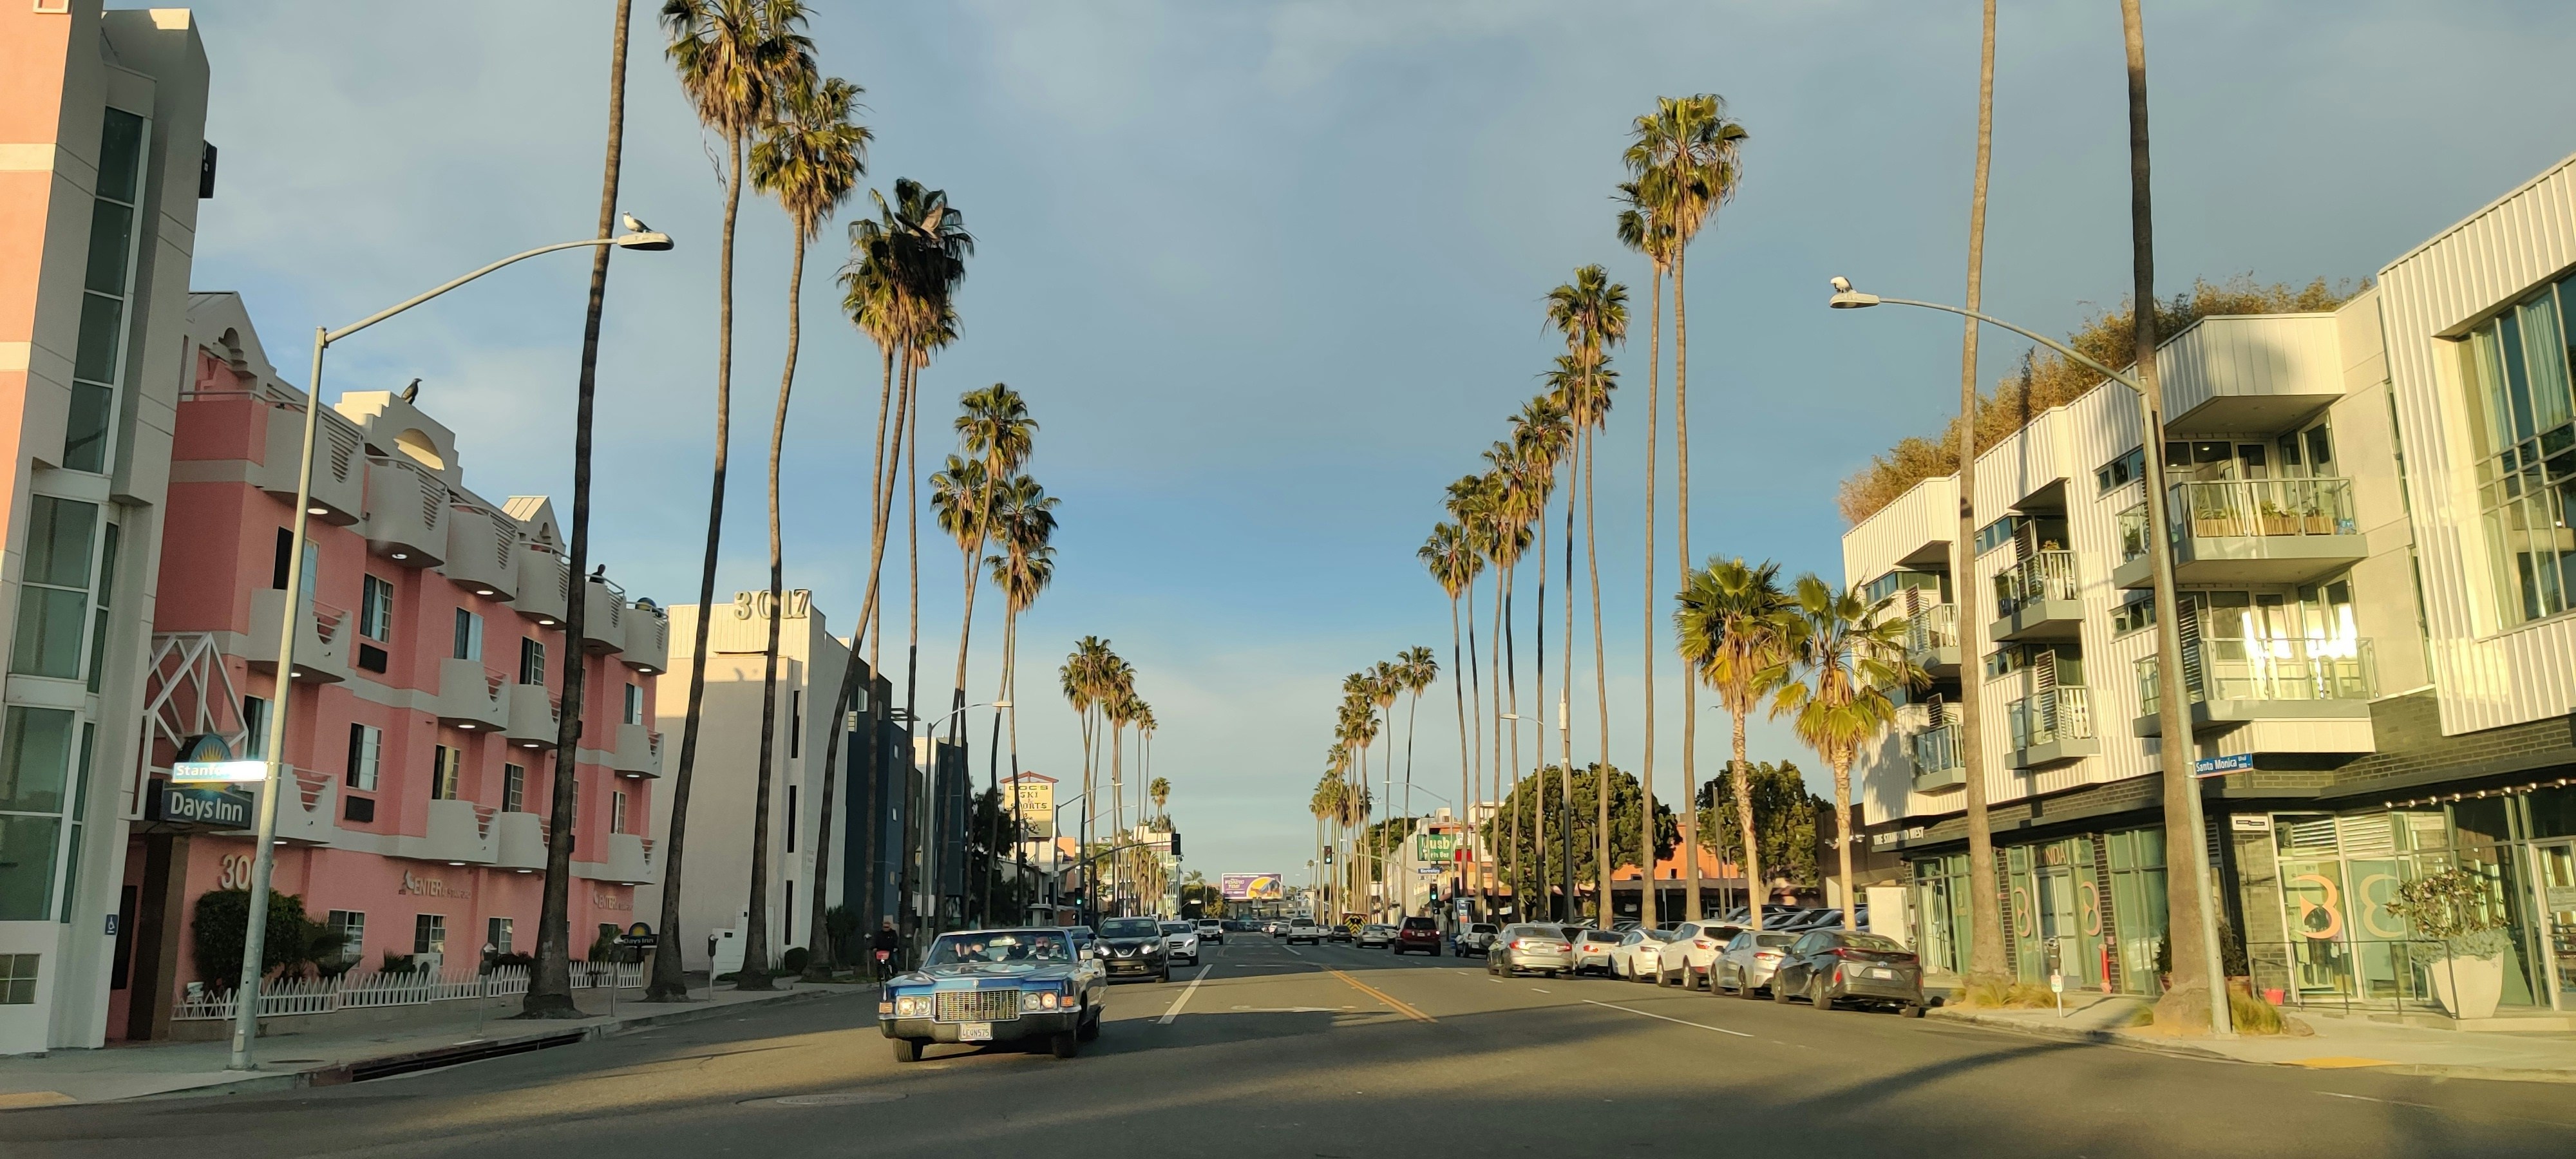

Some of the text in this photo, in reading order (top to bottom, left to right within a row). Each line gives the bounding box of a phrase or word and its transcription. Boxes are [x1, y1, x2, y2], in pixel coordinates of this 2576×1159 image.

[734, 589, 810, 619] 3017
[2196, 762, 2213, 772] Santa
[2215, 757, 2237, 769] Monica
[171, 792, 243, 822] Days Inn
[1873, 834, 1884, 845] THE
[1909, 826, 1924, 840] WEST
